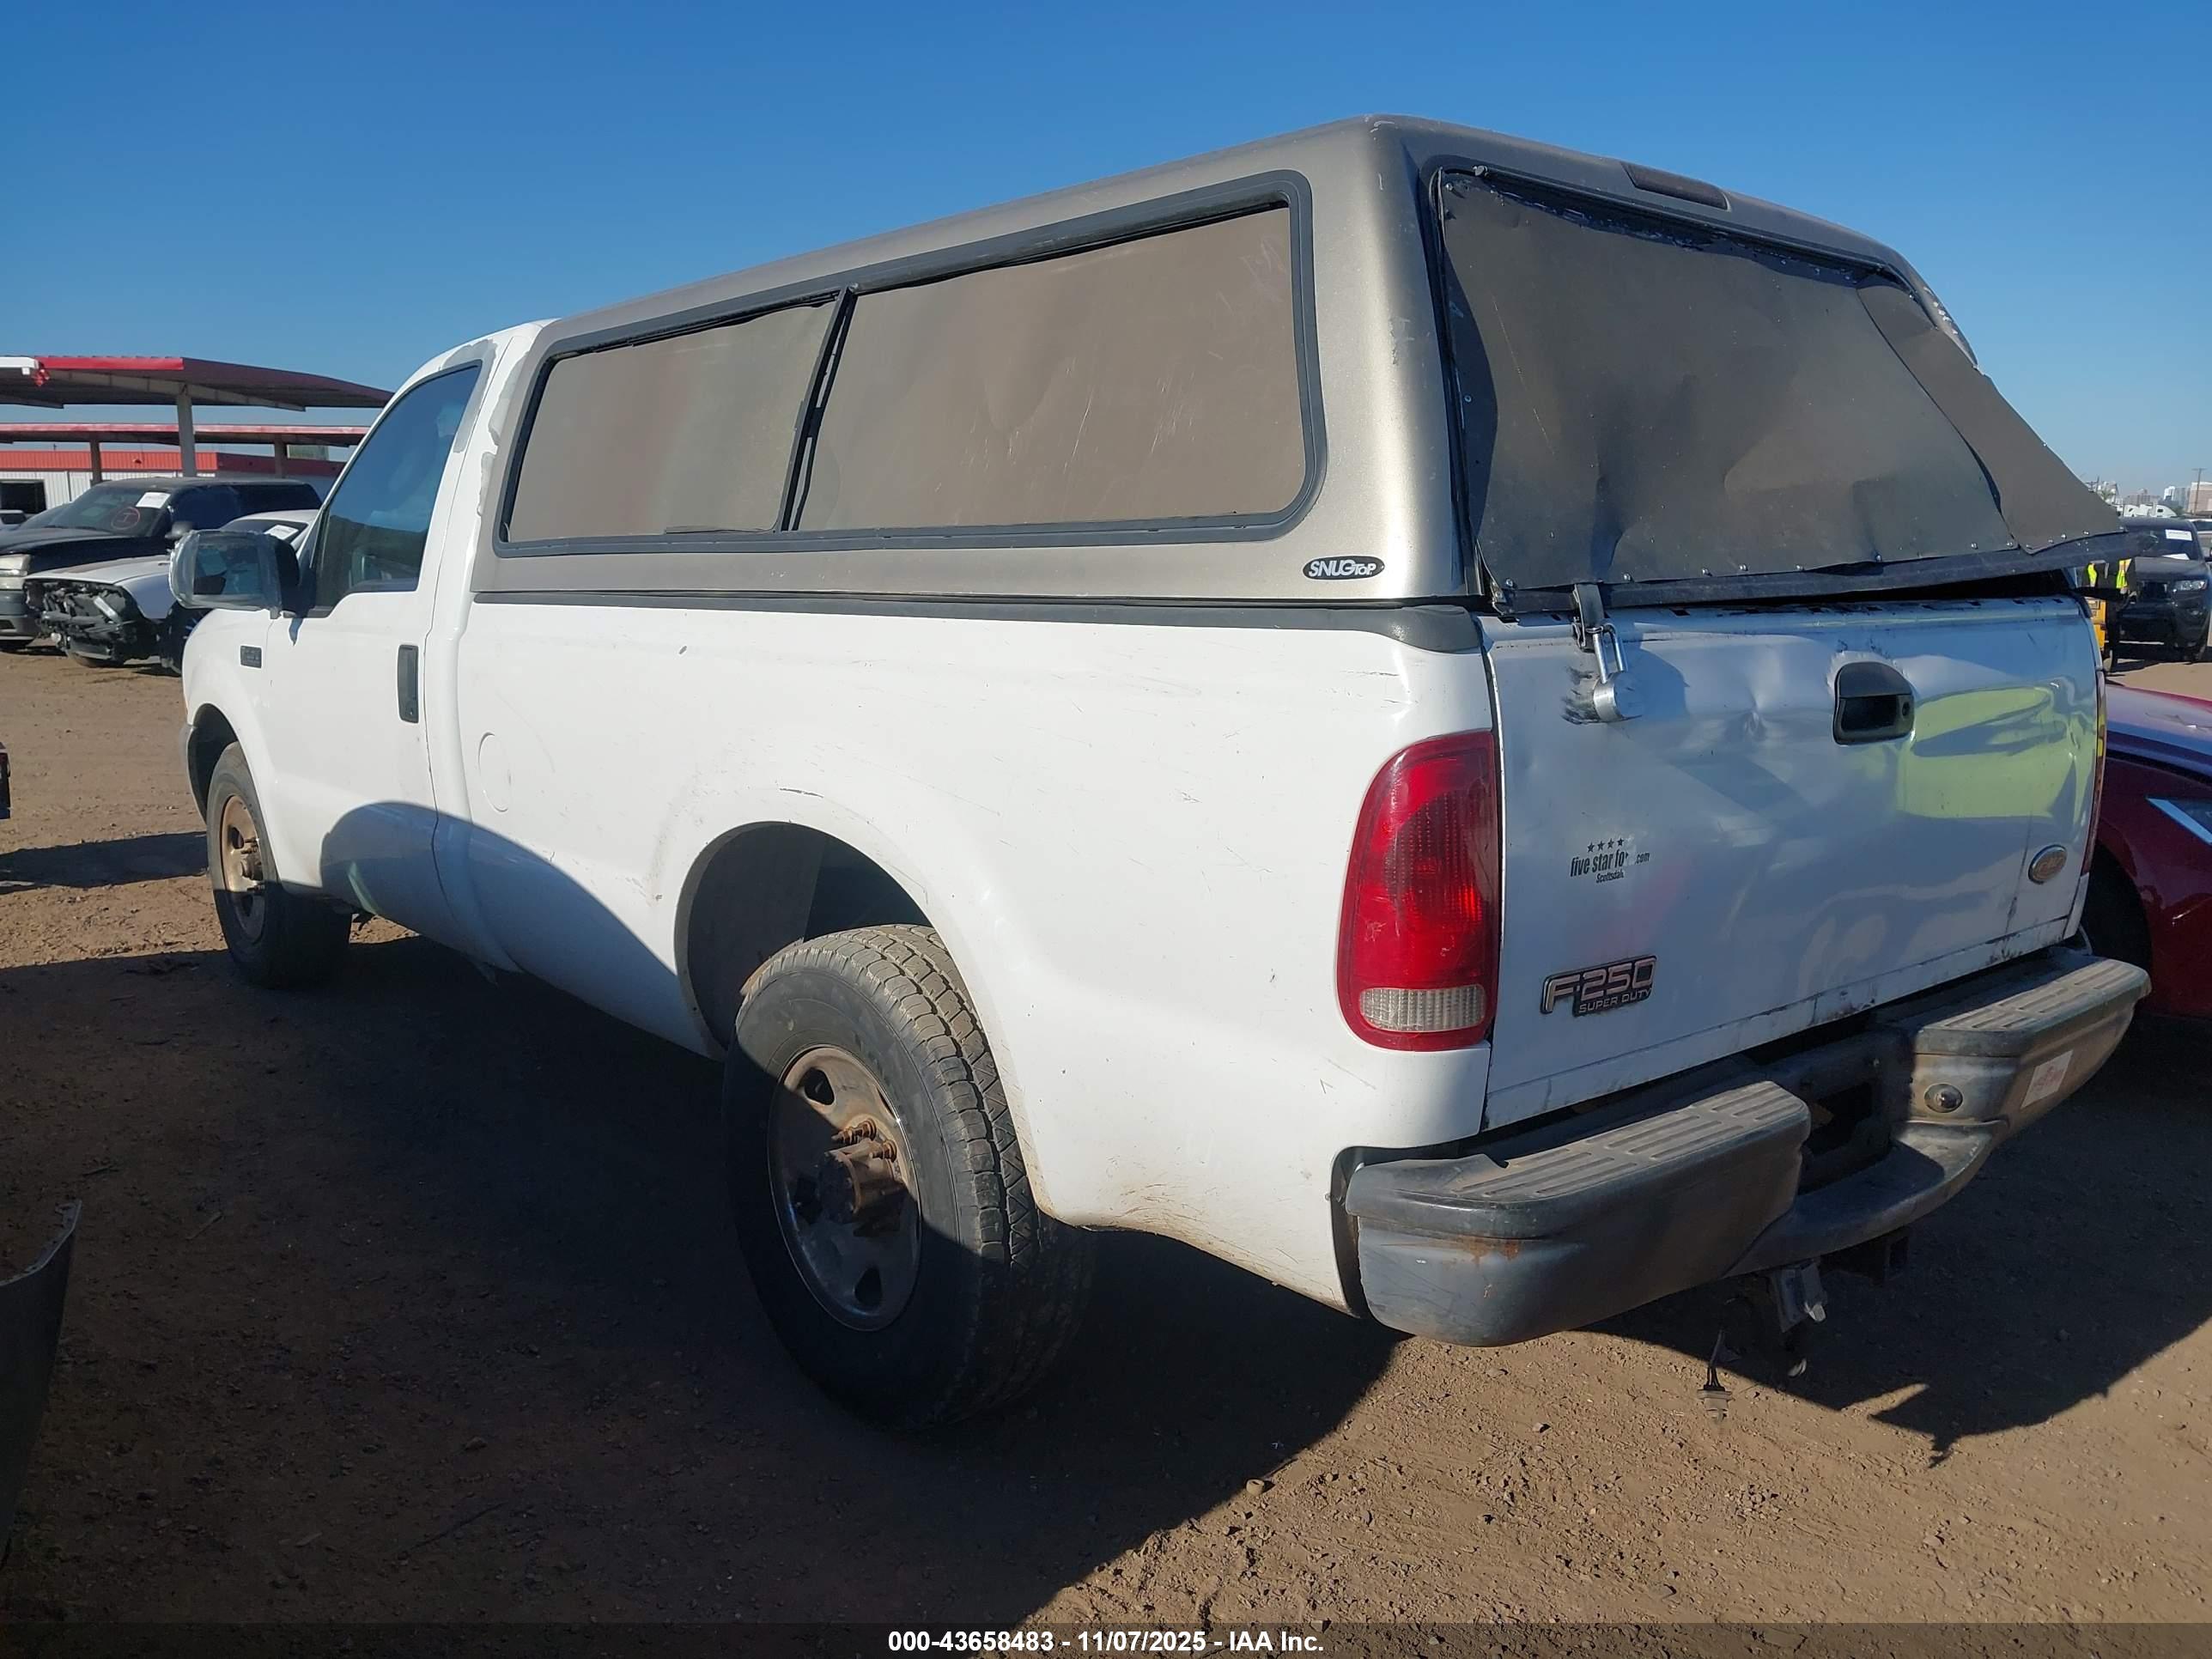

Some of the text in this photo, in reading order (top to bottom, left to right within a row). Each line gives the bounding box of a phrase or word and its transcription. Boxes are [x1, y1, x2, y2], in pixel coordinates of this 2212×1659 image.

[1570, 856, 1590, 878] five
[1592, 853, 1614, 873] star
[1578, 988, 1653, 1014] SUPER DUTY
